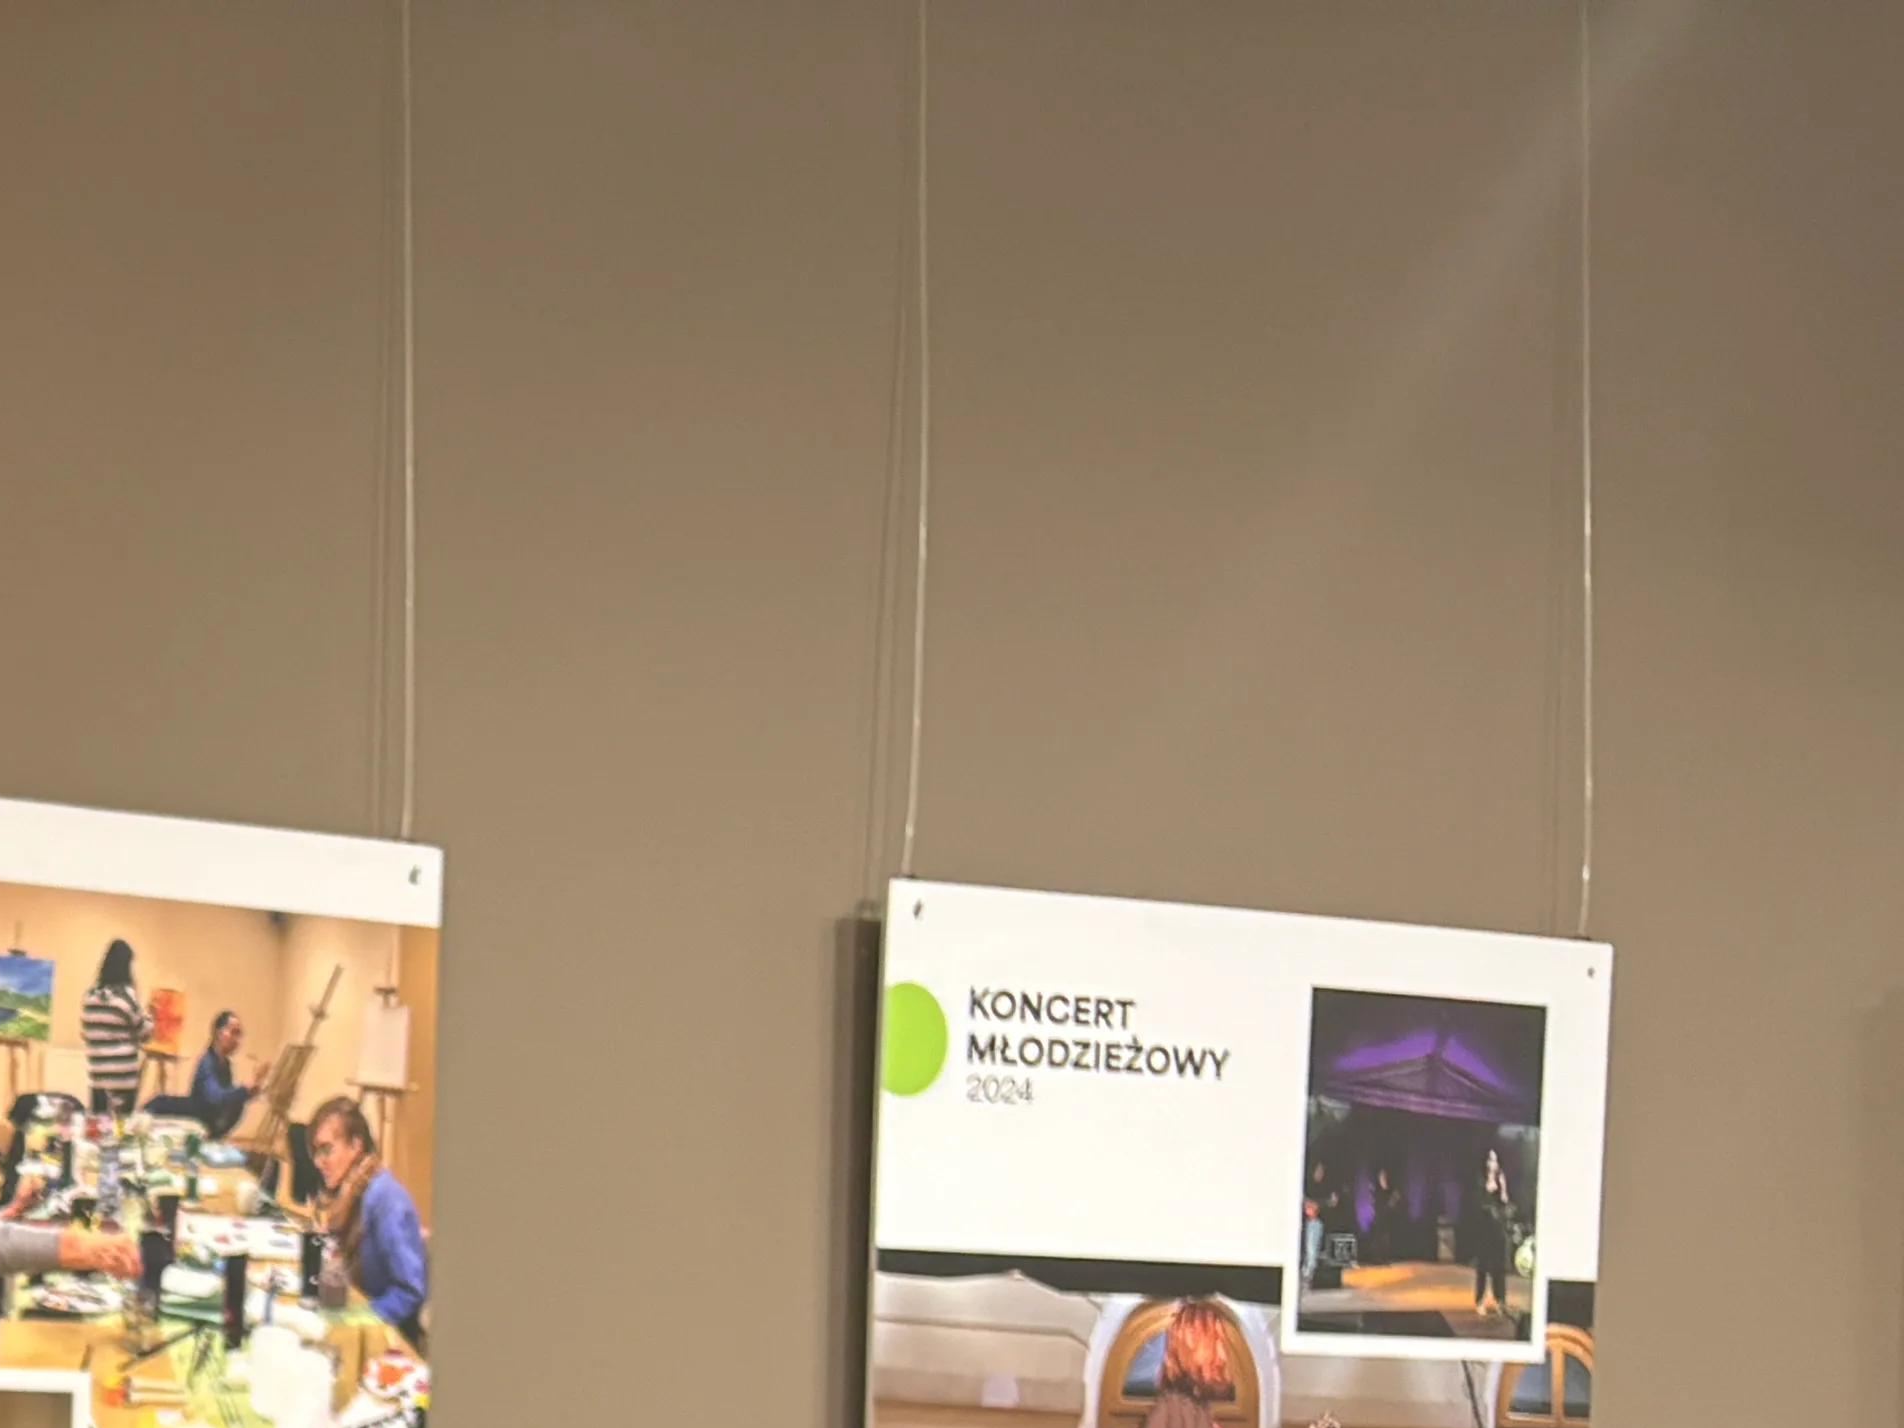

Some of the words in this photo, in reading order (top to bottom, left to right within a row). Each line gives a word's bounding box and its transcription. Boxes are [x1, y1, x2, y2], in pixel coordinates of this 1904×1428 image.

[969, 985, 1137, 1030] KONCERT
[967, 1031, 1231, 1080] MŁODZIEŻOWY
[966, 1073, 1034, 1105] 2024
